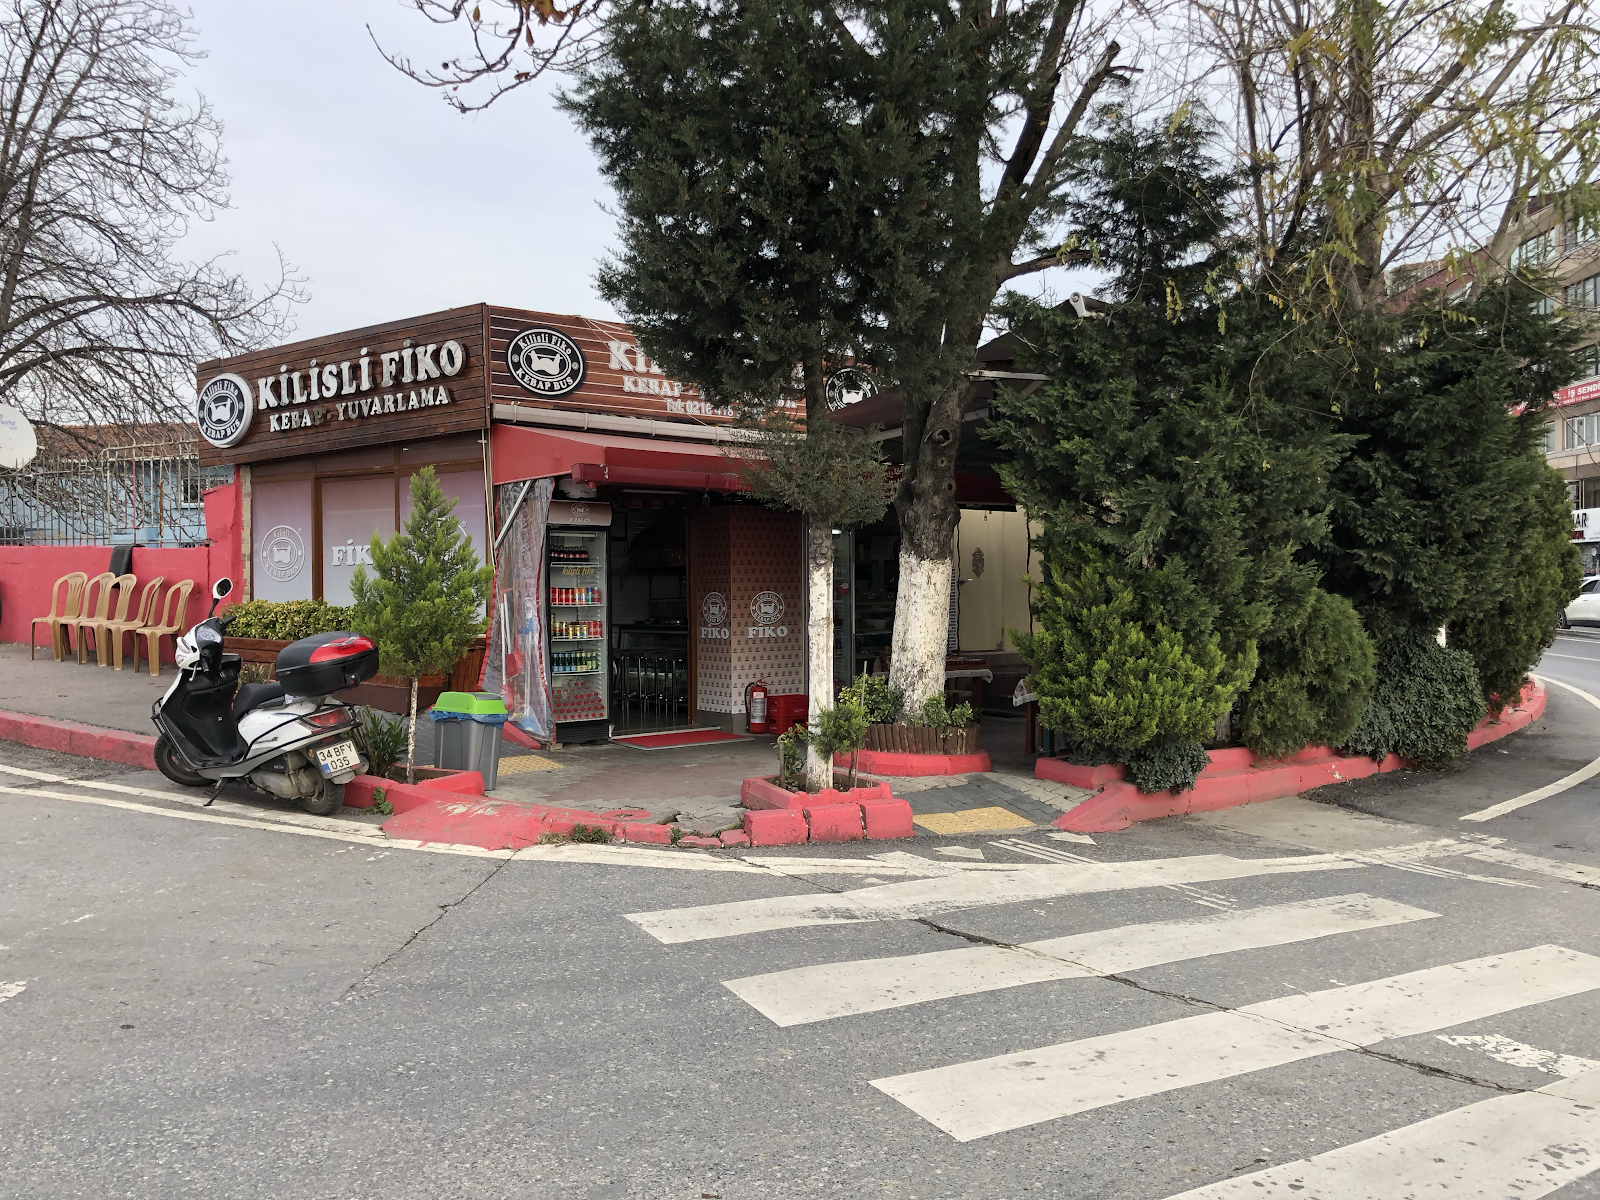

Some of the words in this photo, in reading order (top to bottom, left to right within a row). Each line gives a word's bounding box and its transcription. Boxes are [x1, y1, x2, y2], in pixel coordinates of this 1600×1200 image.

[517, 333, 549, 349] Kilisli
[551, 335, 572, 355] Fiko
[257, 346, 370, 410] KİLİSLİ
[379, 339, 464, 388] FİKO
[516, 367, 551, 390] KEBAP
[553, 376, 574, 390] BUS
[202, 380, 223, 403] Kilisli
[223, 380, 239, 396] Fiko
[269, 406, 325, 433] KEBAP
[335, 385, 449, 421] YUVARLAMA
[202, 422, 226, 439] KEBAP
[226, 418, 241, 437] BUS
[319, 749, 333, 762] 34
[333, 742, 353, 757] BFY
[330, 756, 350, 770] 035
